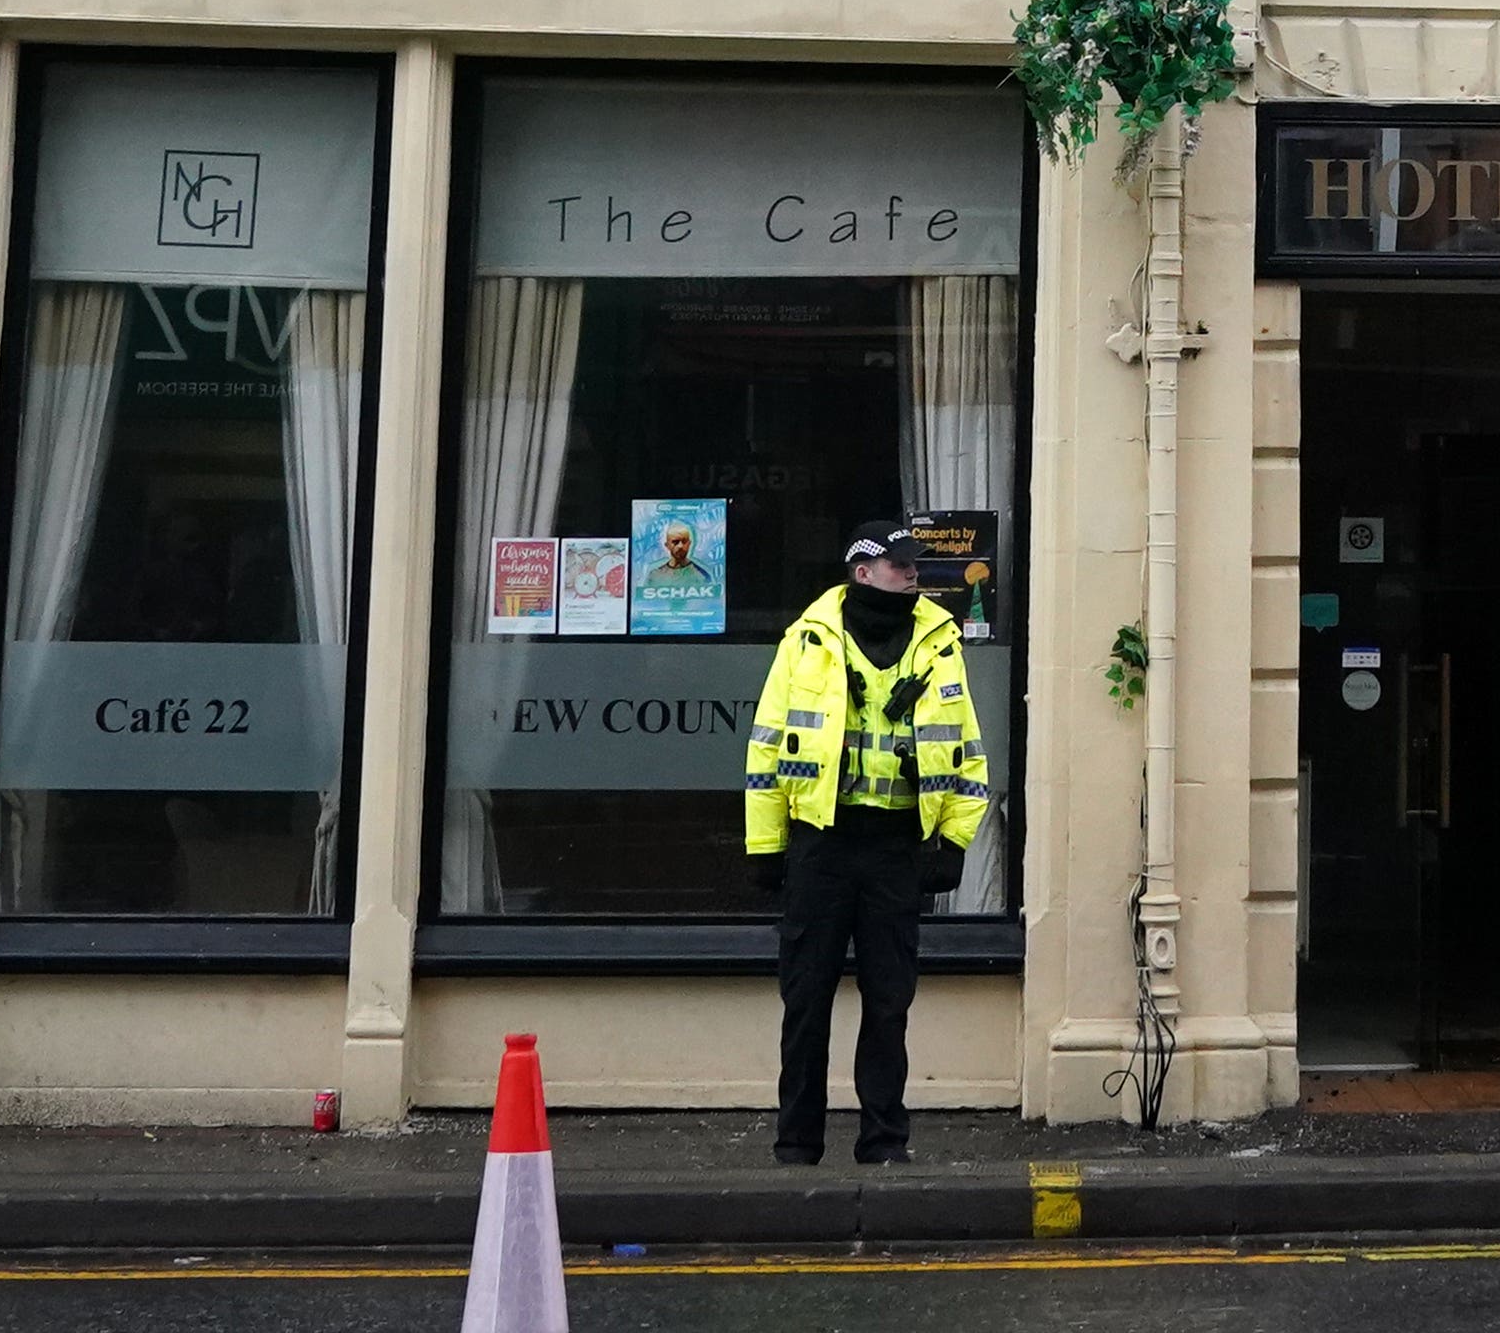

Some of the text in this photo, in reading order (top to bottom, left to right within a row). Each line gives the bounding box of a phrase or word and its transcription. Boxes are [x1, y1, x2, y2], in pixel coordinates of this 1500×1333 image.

[546, 194, 960, 245] The Cafe
[912, 527, 976, 542] Concerts by
[643, 586, 714, 599] SCHAK
[95, 696, 251, 735] Café 22
